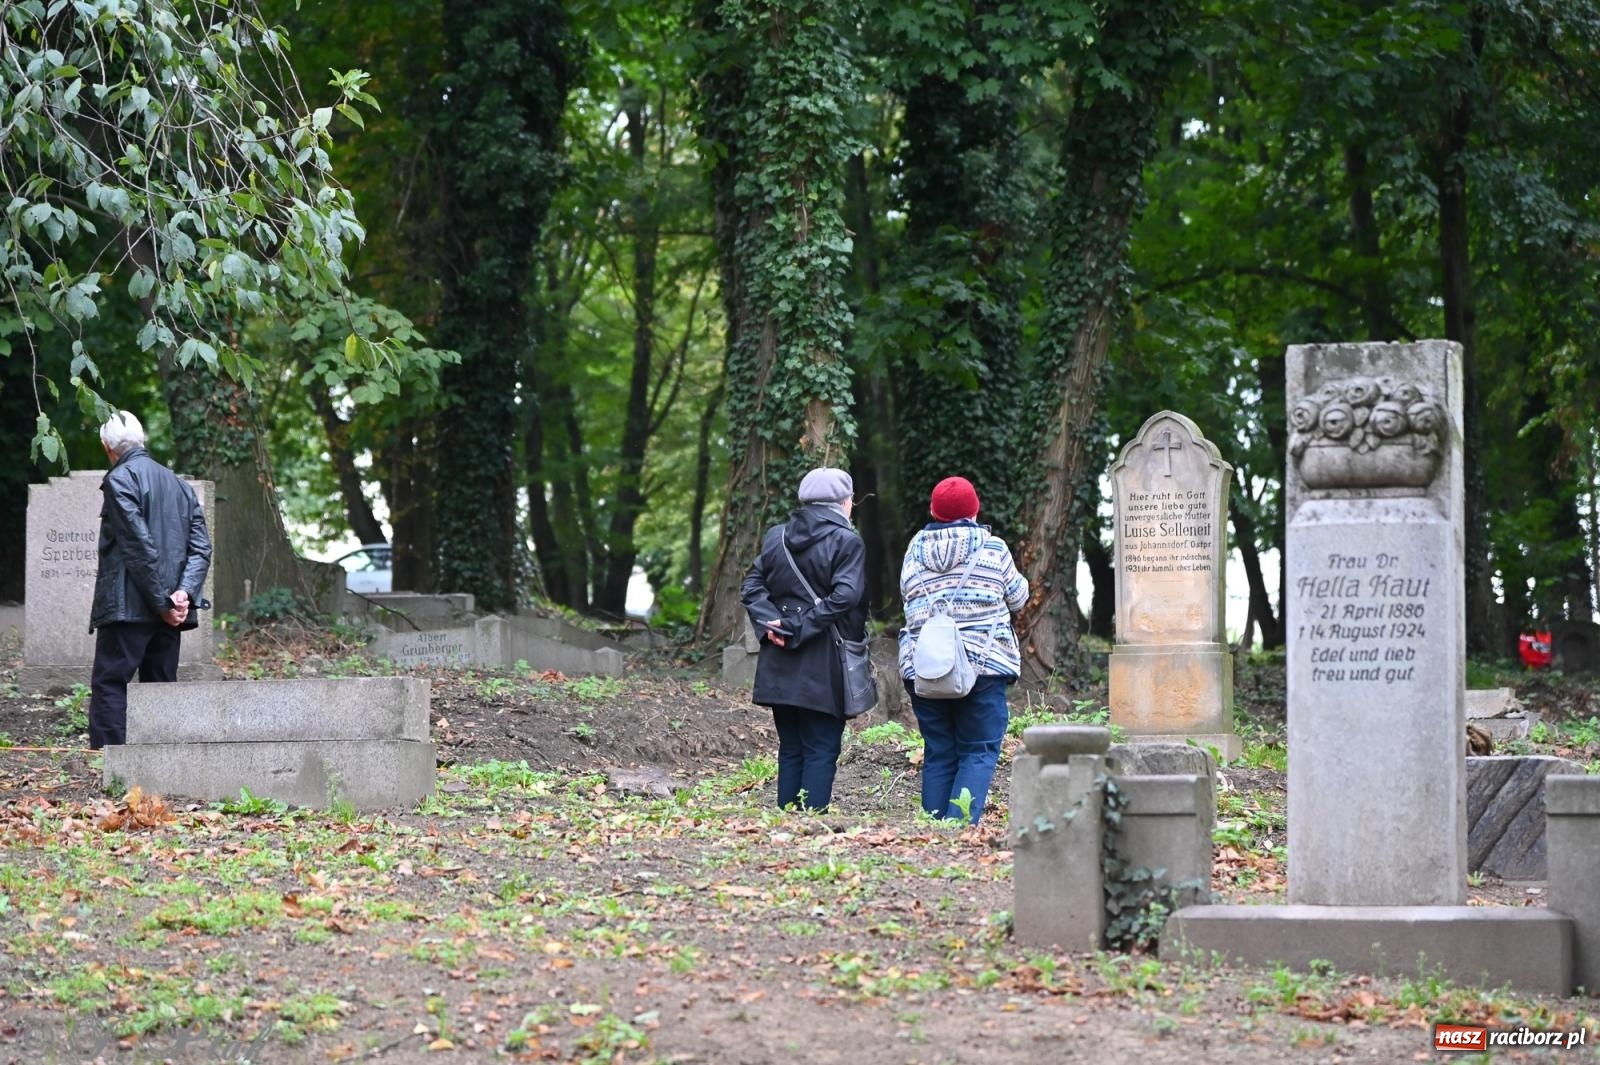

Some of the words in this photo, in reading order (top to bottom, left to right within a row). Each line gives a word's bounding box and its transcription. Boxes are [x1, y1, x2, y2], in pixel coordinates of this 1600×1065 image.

[1129, 492, 1149, 501] Hier
[1152, 491, 1170, 500] ruht
[1174, 492, 1183, 500] in
[1186, 490, 1206, 500] Gott
[1128, 503, 1159, 511] unsere
[1161, 502, 1185, 511] liebe
[1187, 502, 1207, 512] gute
[1184, 511, 1211, 521] Mutter
[46, 529, 96, 543] Gertrud
[1124, 523, 1156, 538] Luise
[1192, 562, 1212, 571] Leben
[1328, 553, 1367, 569] Frau
[1297, 575, 1360, 598] Hella
[1342, 603, 1386, 621] April
[1328, 623, 1386, 643] August
[1389, 622, 1426, 639] 1924
[1310, 646, 1346, 663] Edel
[1349, 647, 1379, 662] und
[1384, 646, 1416, 662] lieb
[1312, 667, 1346, 682] treu
[1349, 666, 1381, 681] und
[1384, 666, 1415, 684] gut
